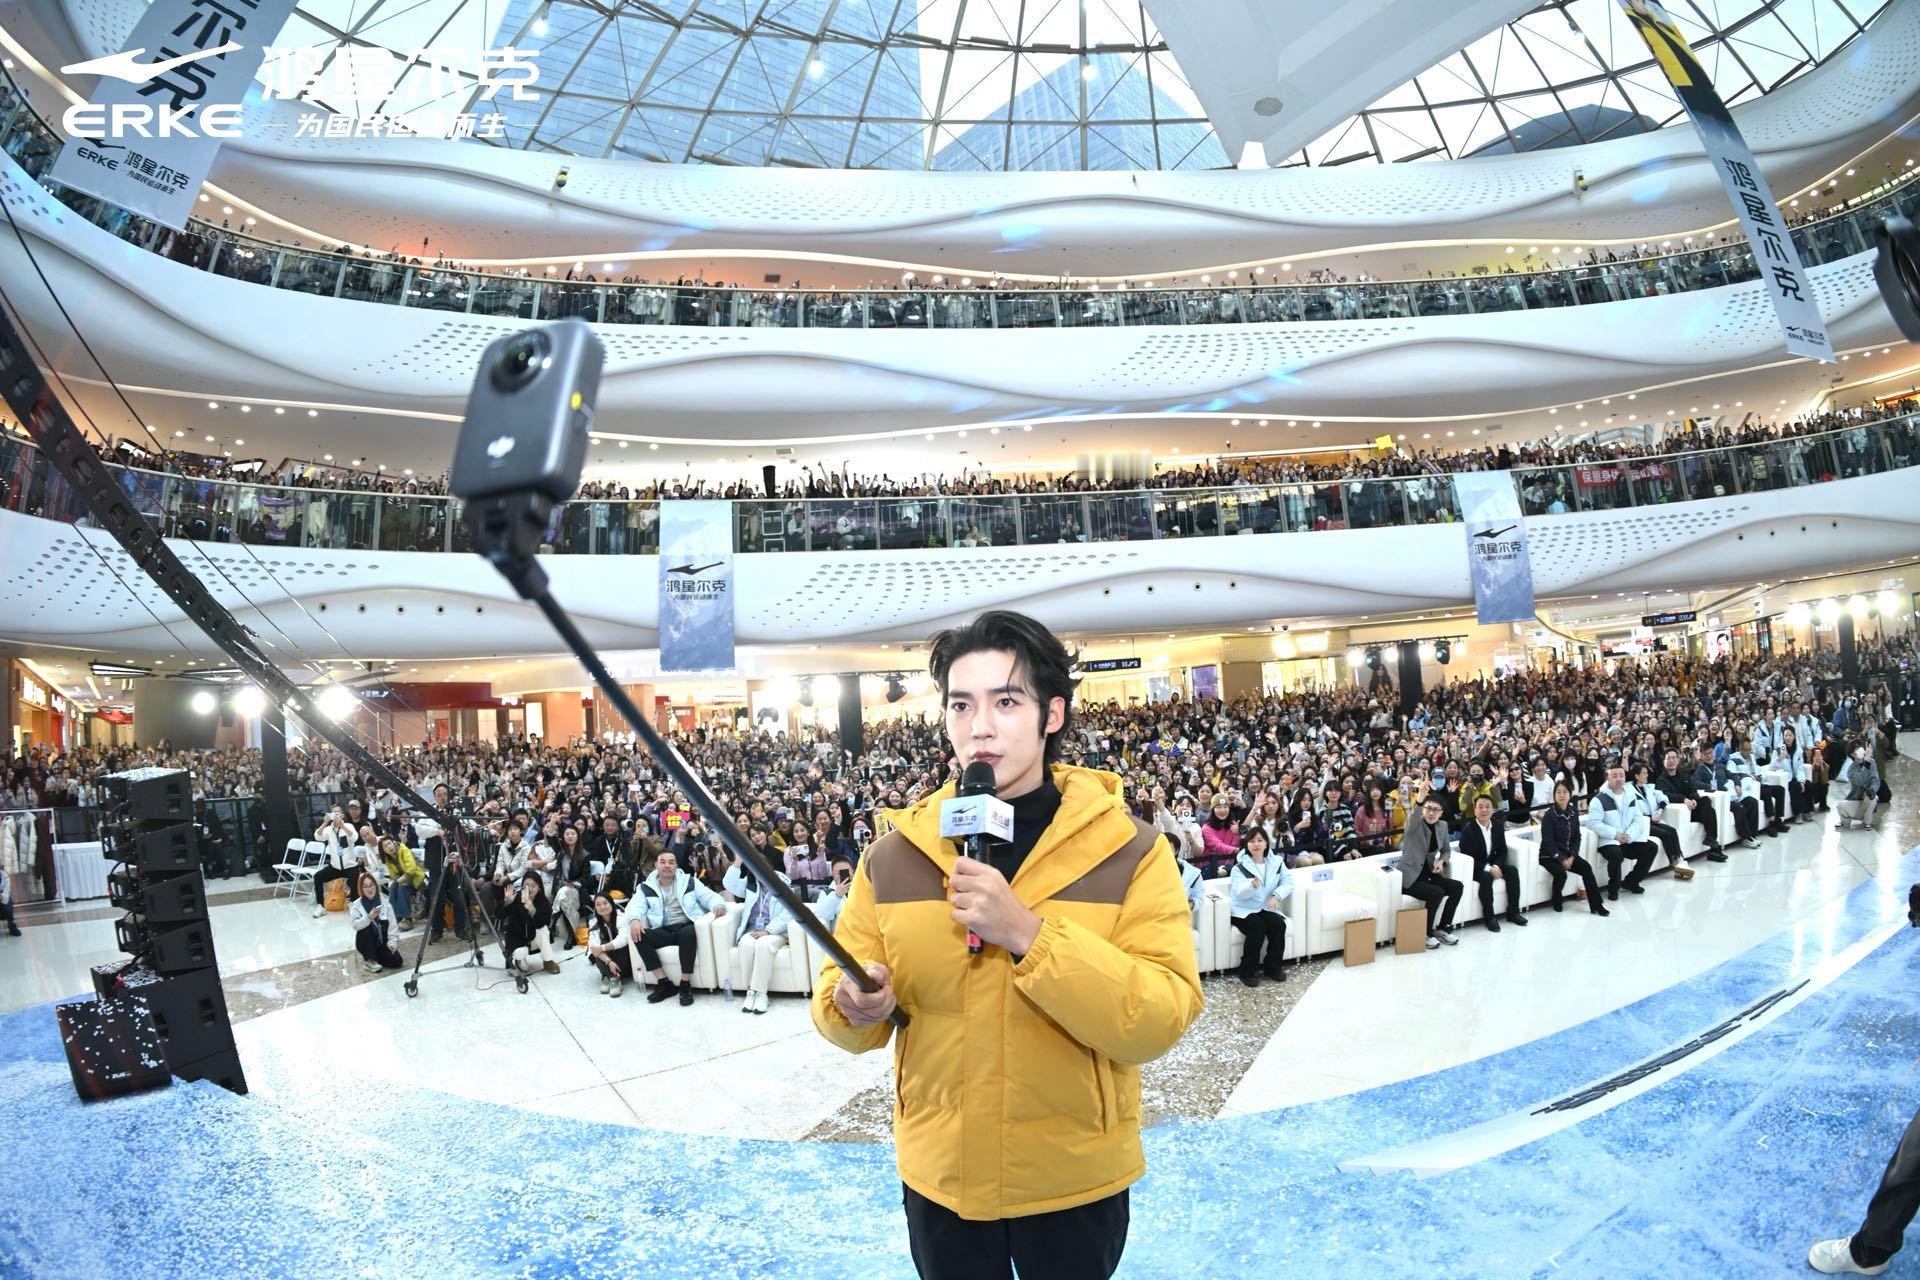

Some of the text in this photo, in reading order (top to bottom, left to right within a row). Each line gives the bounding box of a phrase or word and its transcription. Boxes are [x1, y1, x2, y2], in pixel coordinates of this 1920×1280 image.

[76, 147, 120, 171] ERKE
[123, 150, 191, 190] 鸿星尔克
[1722, 156, 1806, 302] 鸿星尔克
[1474, 541, 1523, 555] 鸿星尔克
[666, 580, 727, 593] 鸿星尔克
